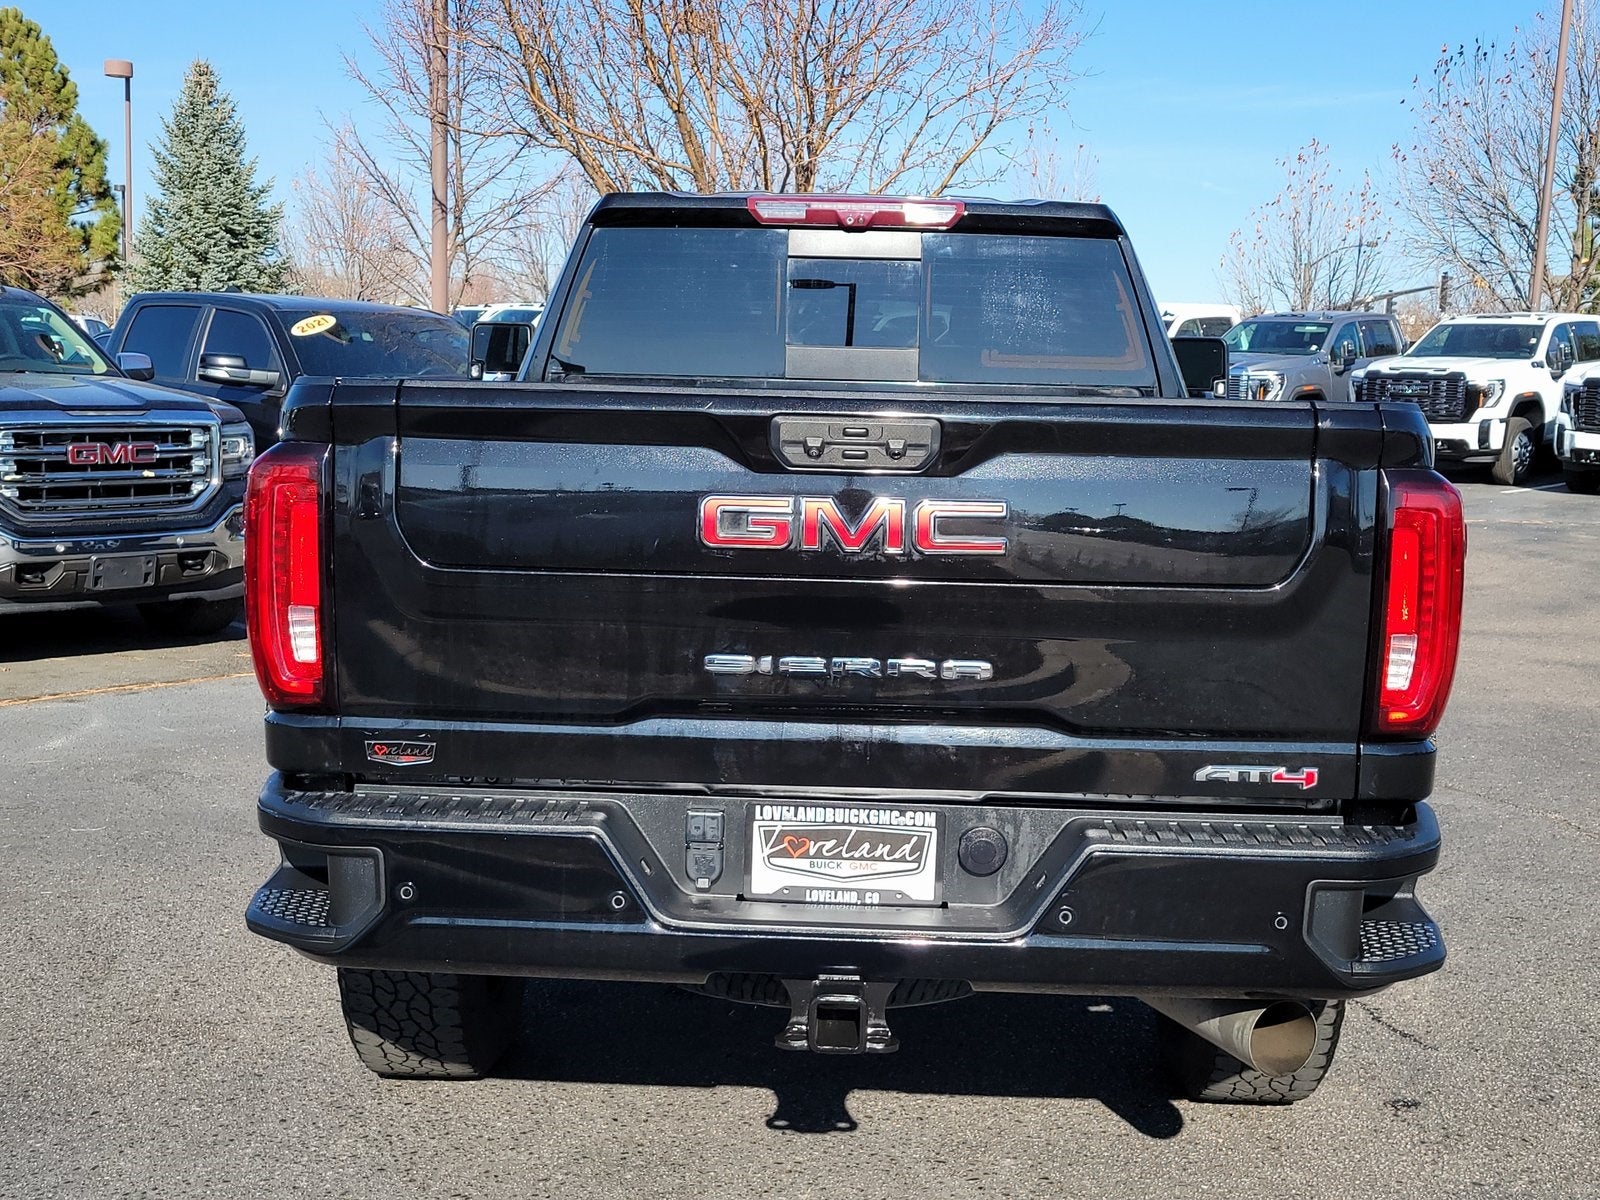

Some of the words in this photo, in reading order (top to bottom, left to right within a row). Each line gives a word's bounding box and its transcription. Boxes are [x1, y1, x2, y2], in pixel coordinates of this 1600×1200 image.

[297, 317, 329, 333] 2021
[68, 442, 158, 464] GMC
[699, 495, 1008, 555] GMC
[703, 654, 993, 680] SIERRA
[1194, 765, 1319, 790] AT4
[755, 805, 937, 827] LOVELANDBUICKGMC.COM
[809, 860, 843, 870] BUICK
[849, 862, 878, 871] GMC
[805, 889, 861, 905] LOVELAND,
[865, 892, 880, 904] CO
